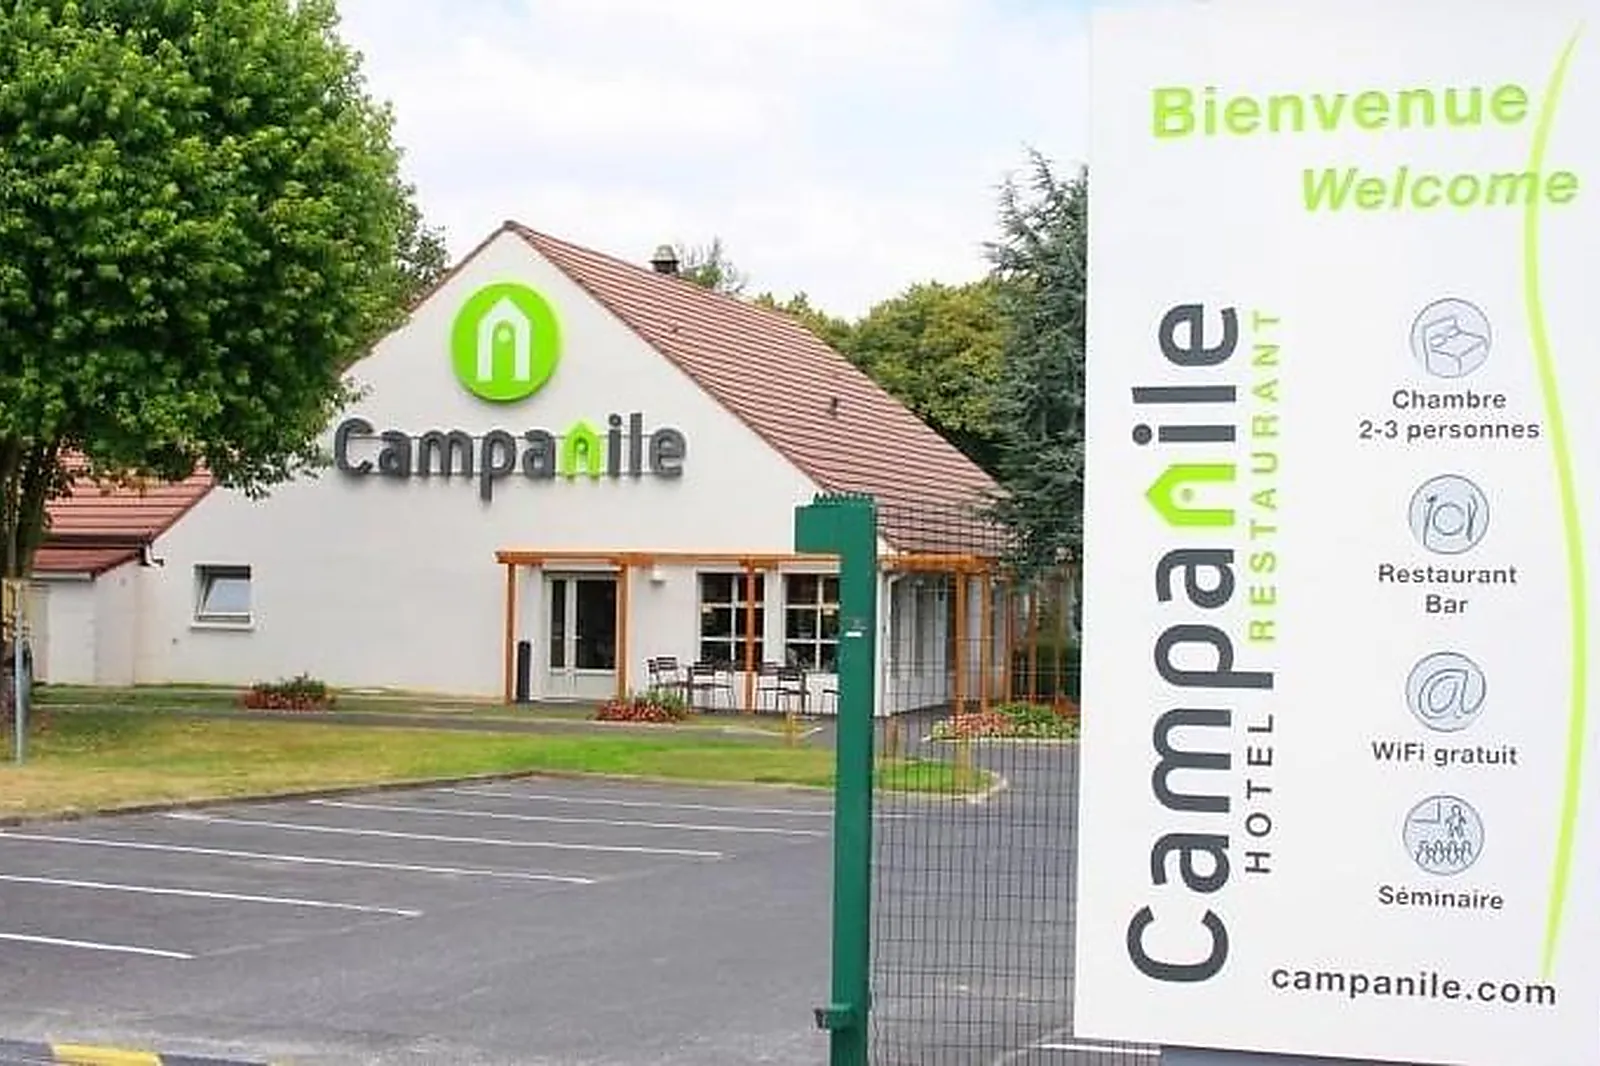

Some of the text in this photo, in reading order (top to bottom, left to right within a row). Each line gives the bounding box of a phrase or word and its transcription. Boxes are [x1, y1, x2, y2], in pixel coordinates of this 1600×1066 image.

[1151, 83, 1529, 139] Bienvenue
[1303, 165, 1580, 212] Welcome
[1392, 388, 1507, 410] Chambre
[1359, 419, 1540, 443] 2-3 personnes
[333, 411, 689, 503] Campanile
[1378, 563, 1517, 585] Restaurant
[1244, 309, 1281, 875] HOTEL RESTAURANT
[1425, 593, 1469, 614] Bar
[1126, 302, 1275, 983] Campanile
[1371, 741, 1518, 768] WiFi gratuit
[1378, 884, 1504, 910] Séminaire
[1271, 966, 1557, 1006] campanile.com
